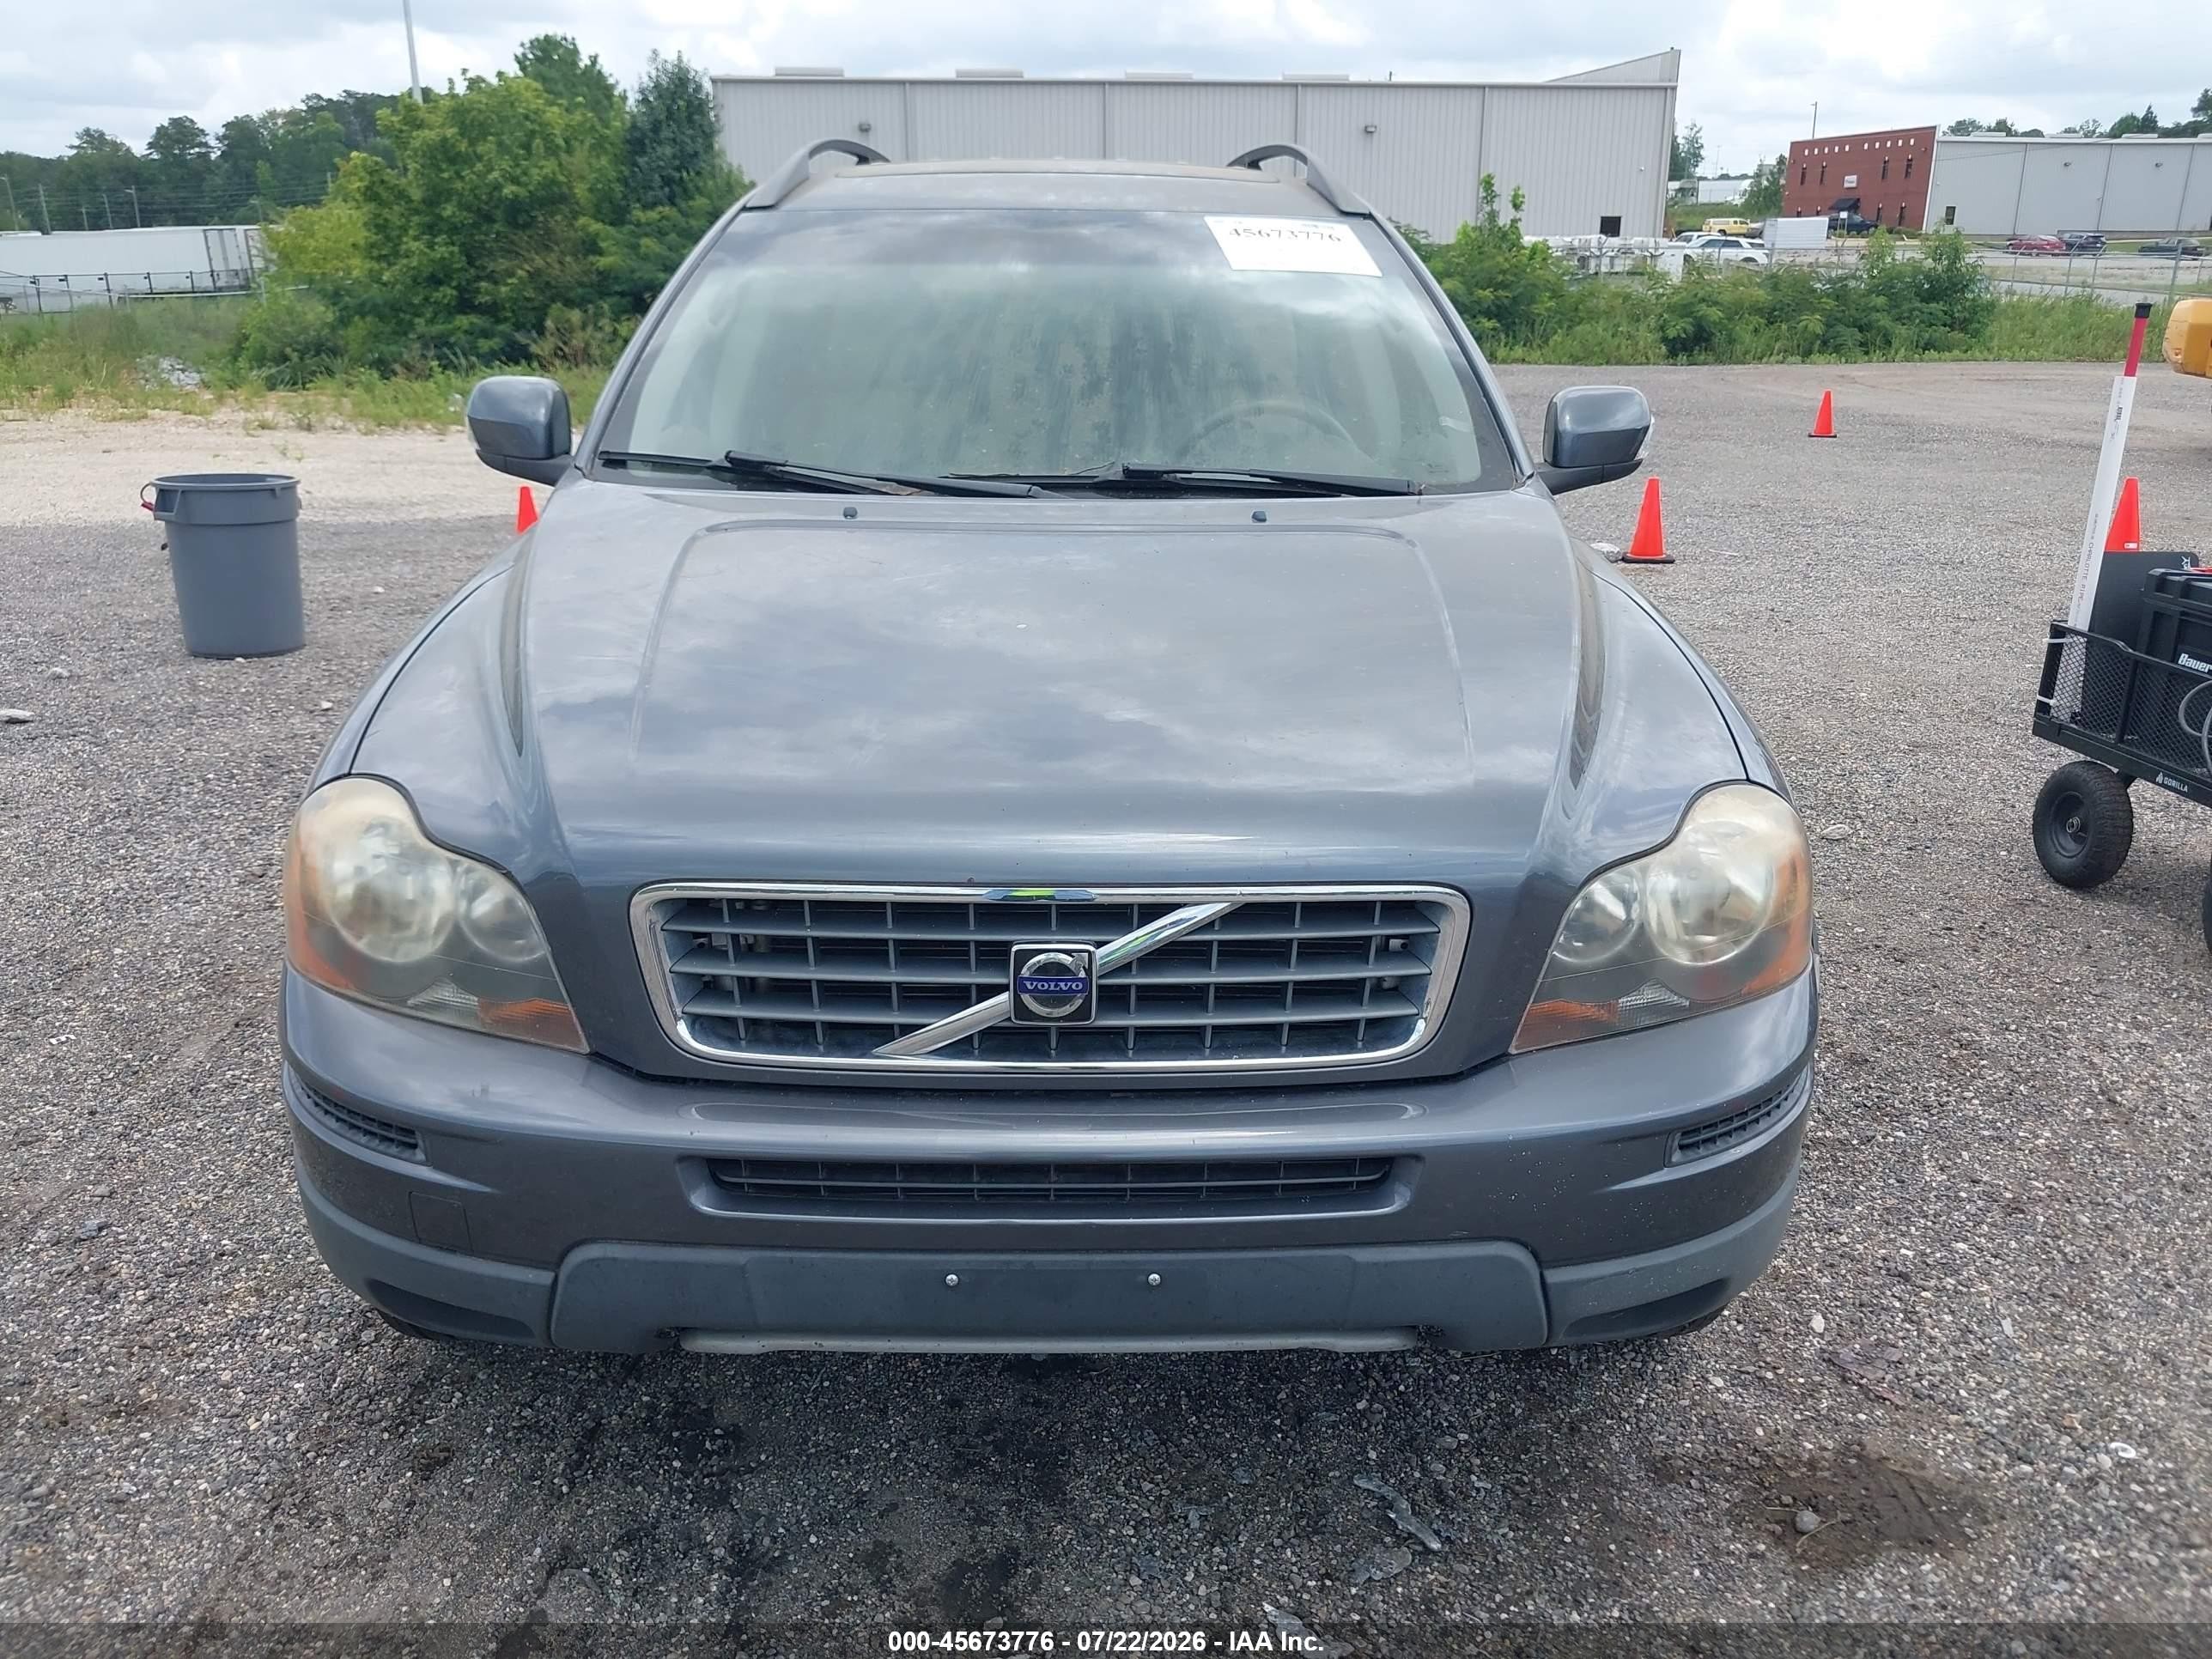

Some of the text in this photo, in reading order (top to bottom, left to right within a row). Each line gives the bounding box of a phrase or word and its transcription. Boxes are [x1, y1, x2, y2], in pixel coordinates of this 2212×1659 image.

[1229, 228, 1341, 242] 45673776
[2178, 653, 2212, 673] Bauer
[2164, 777, 2188, 793] GORILLA
[1023, 981, 1083, 991] VOLVO
